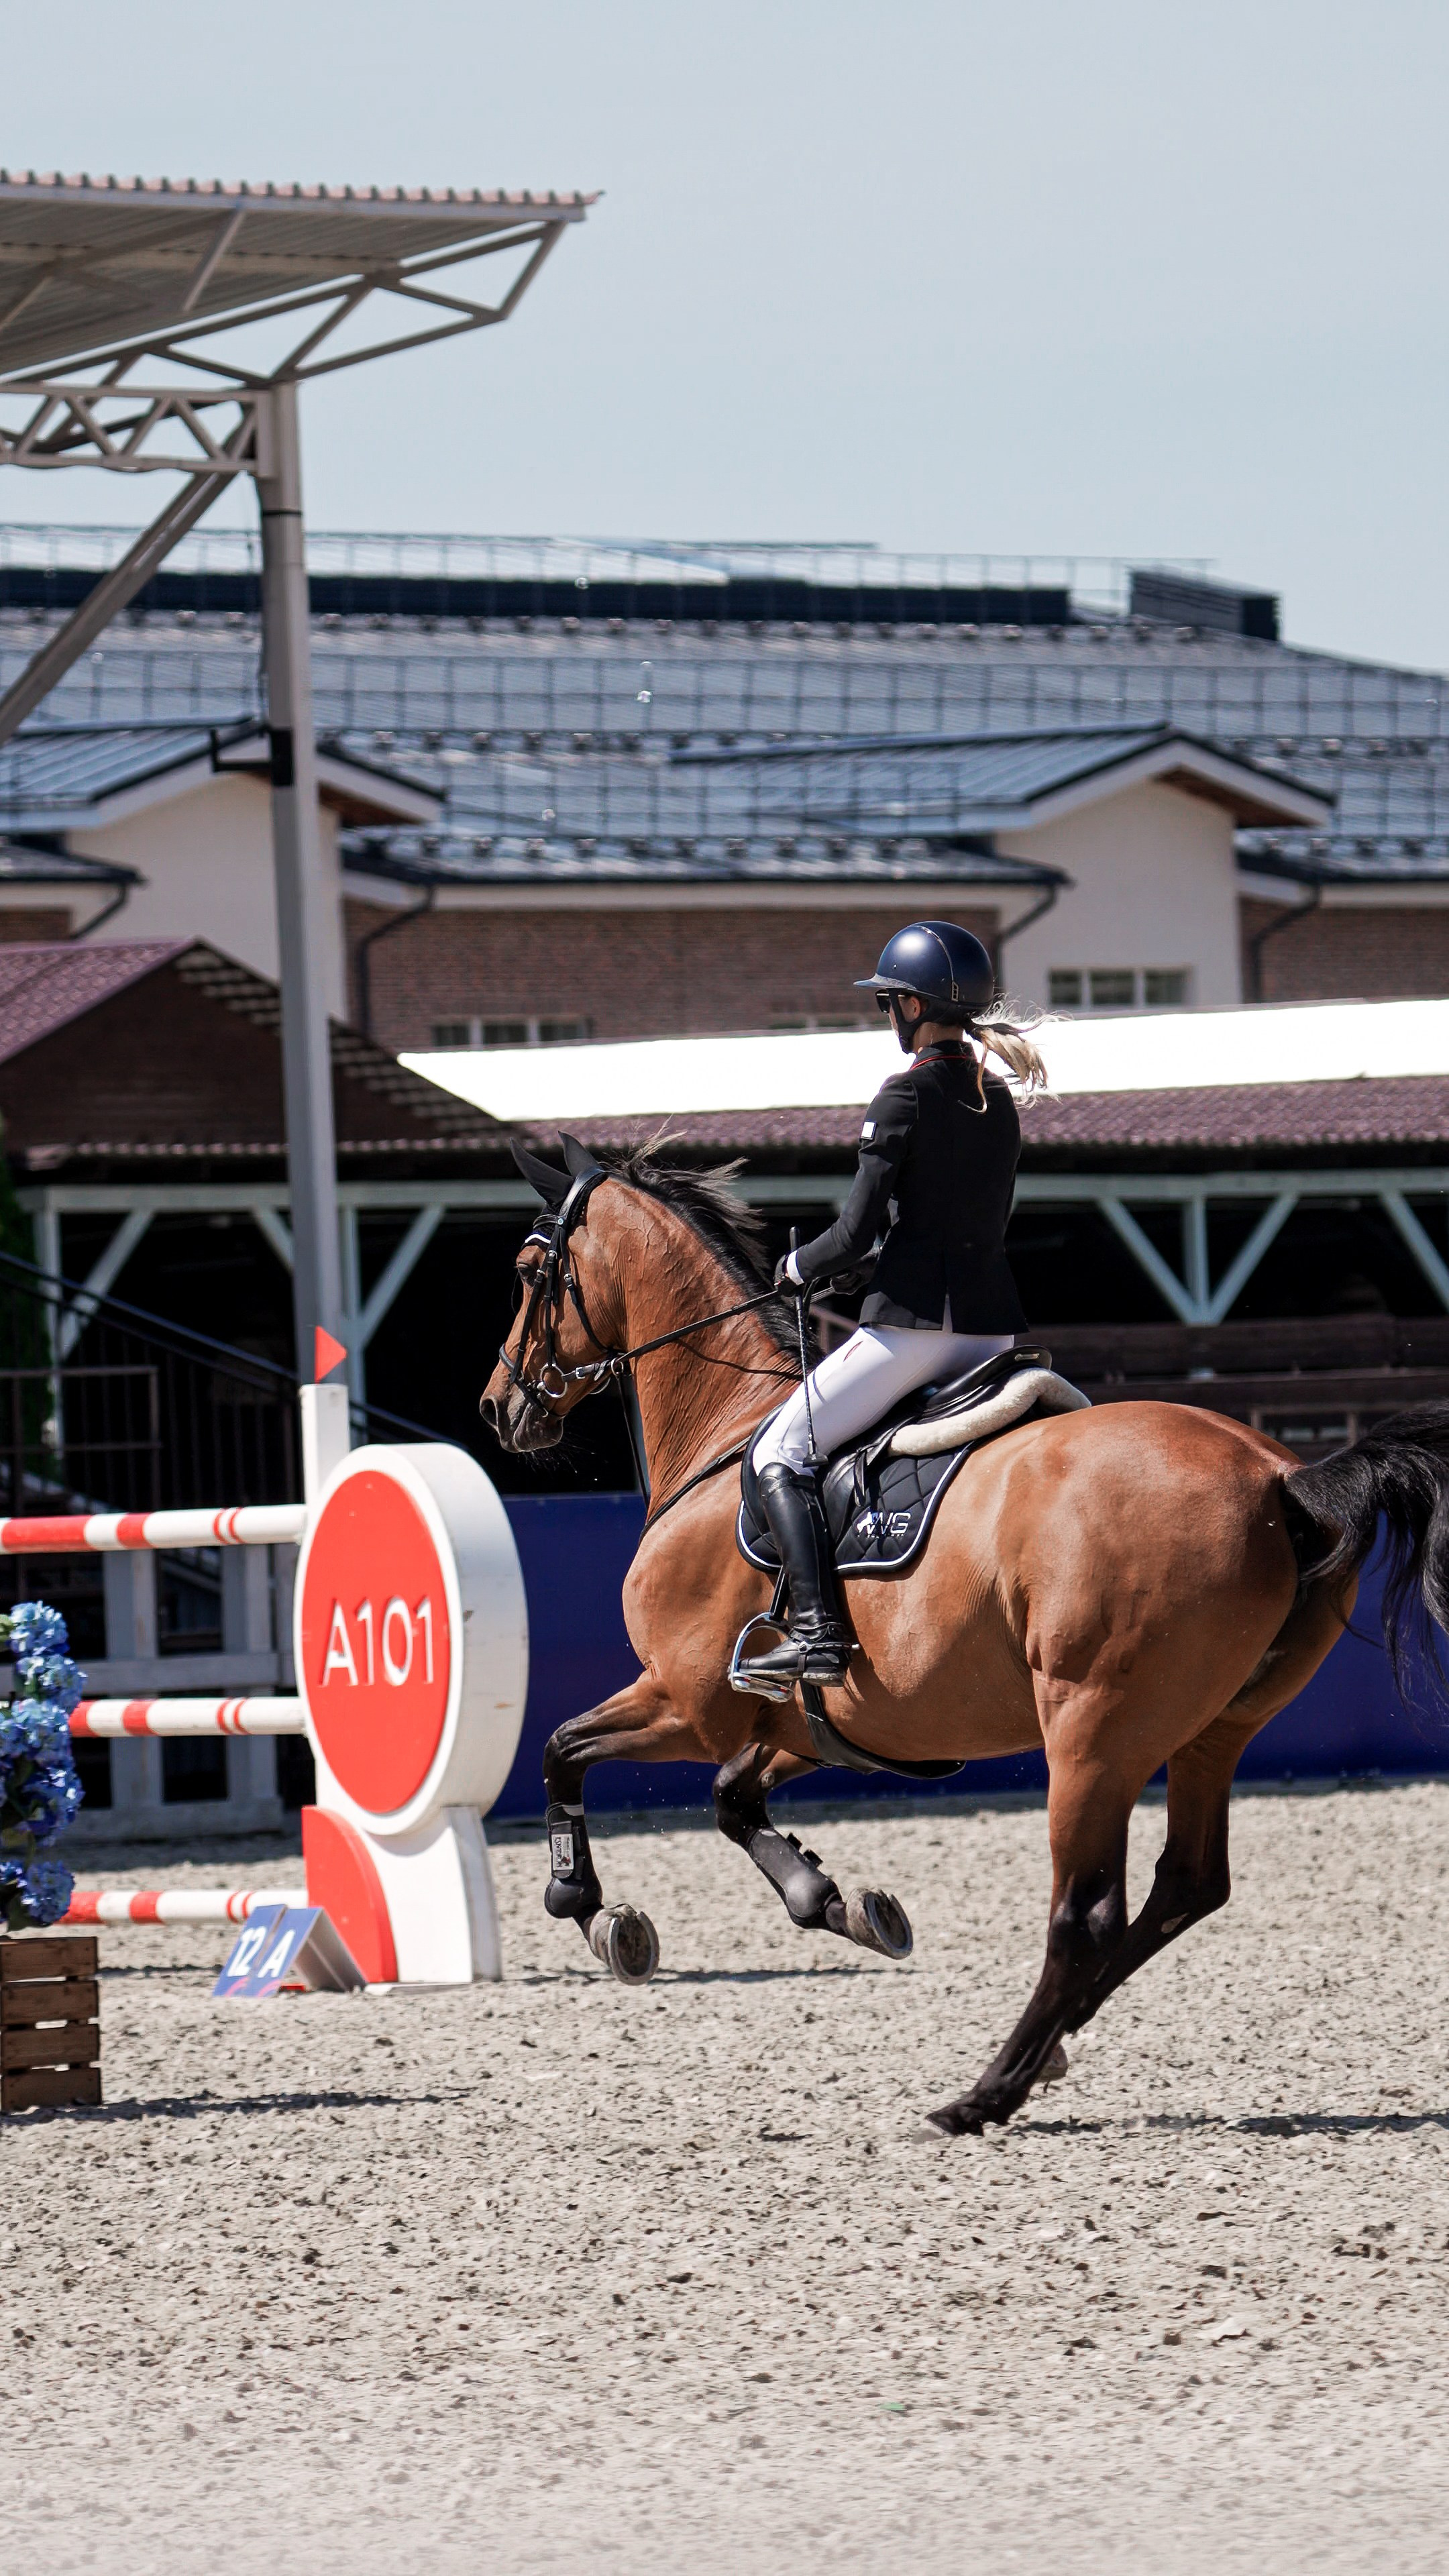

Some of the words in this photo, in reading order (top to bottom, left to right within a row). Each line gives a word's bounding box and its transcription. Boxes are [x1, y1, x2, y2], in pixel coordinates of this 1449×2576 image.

[319, 1595, 434, 1686] A101
[227, 1926, 266, 1977] 12
[258, 1929, 296, 1978] A
